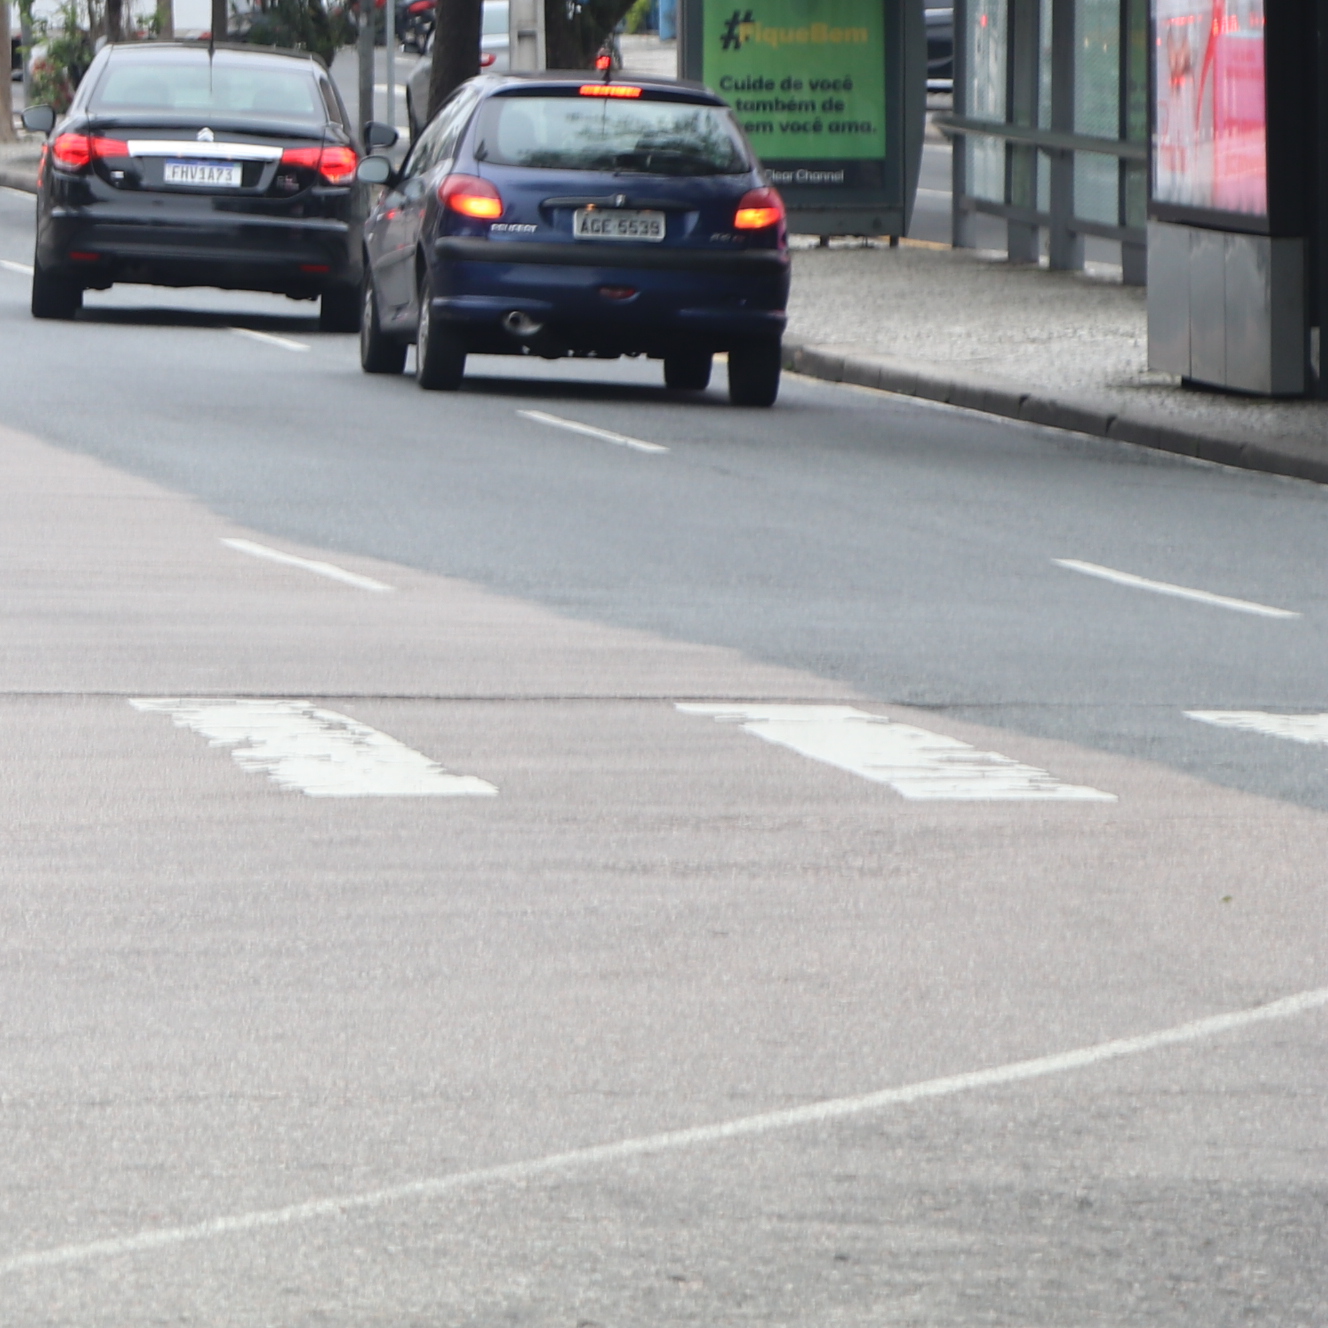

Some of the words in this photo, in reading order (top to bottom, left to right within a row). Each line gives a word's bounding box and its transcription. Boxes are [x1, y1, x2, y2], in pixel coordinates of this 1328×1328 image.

[719, 75, 776, 91] Cuide
[780, 75, 804, 91] de
[808, 74, 854, 91] você
[735, 97, 816, 112] também
[821, 97, 846, 112] de
[780, 117, 823, 133] você
[828, 121, 877, 133] ama.
[170, 165, 233, 182] FHV1A73
[796, 169, 845, 183] Channel
